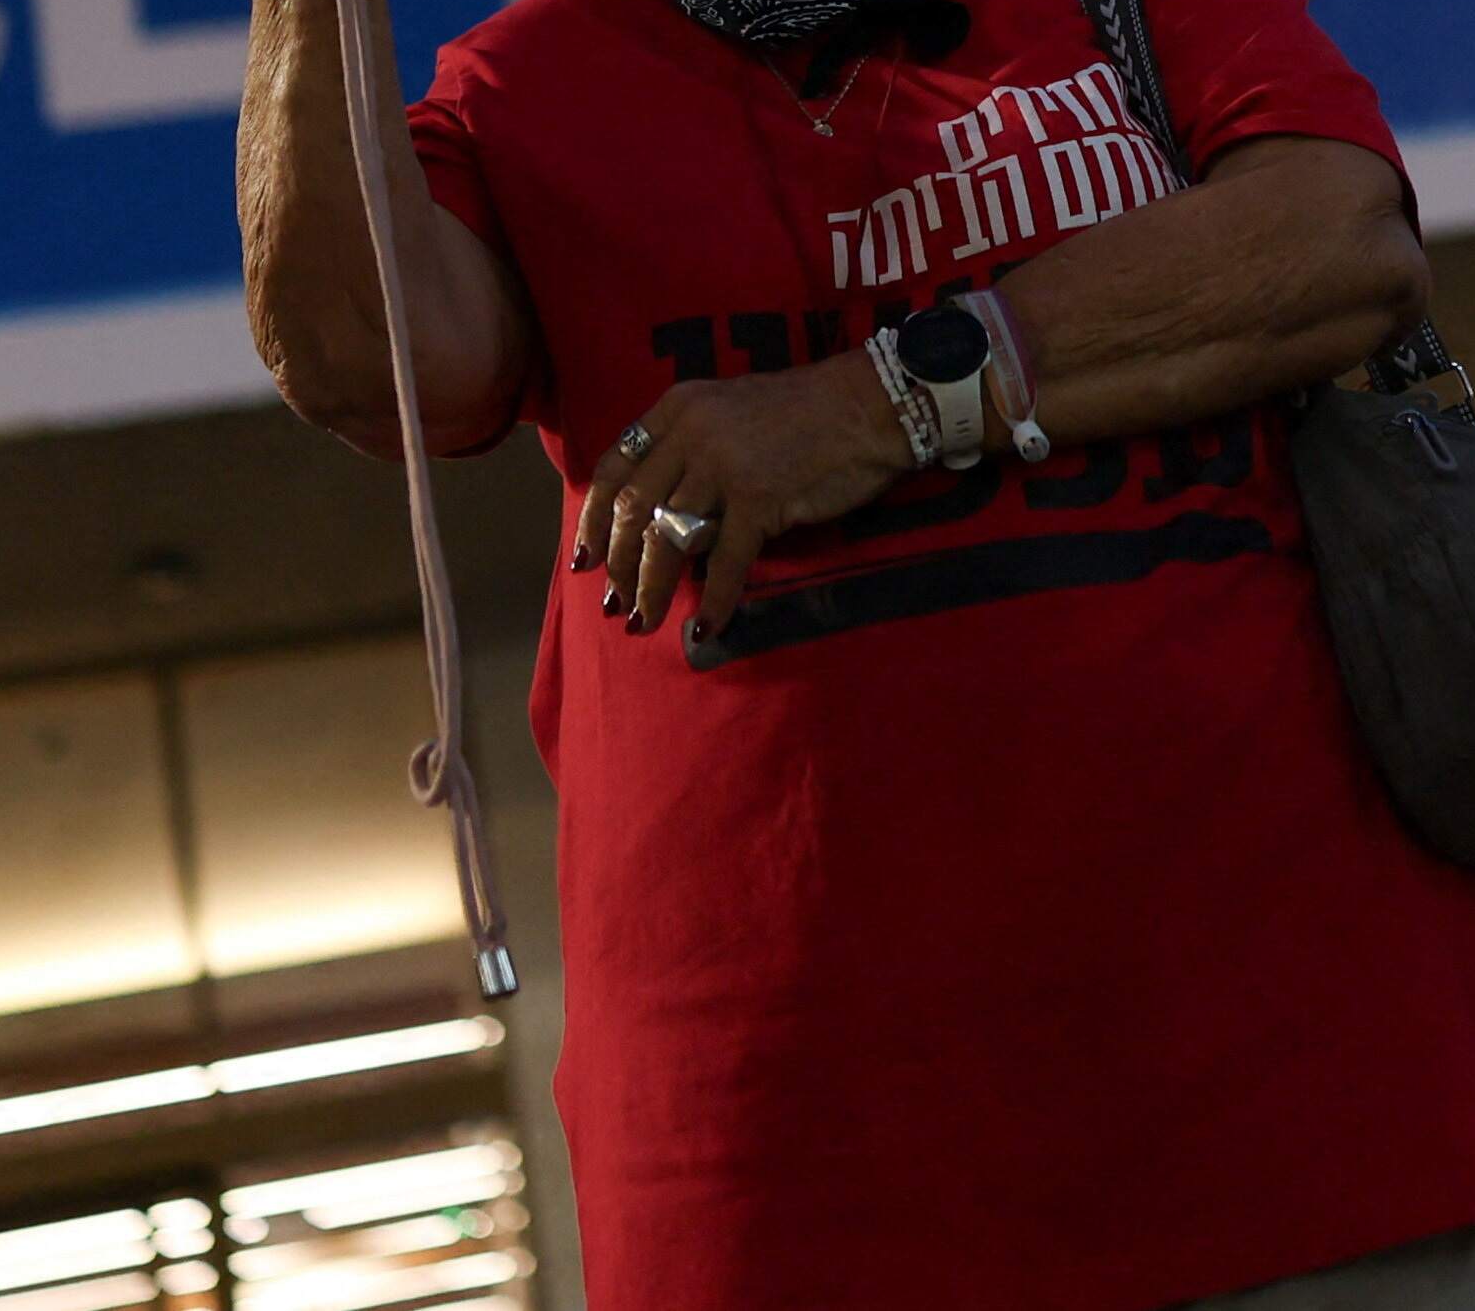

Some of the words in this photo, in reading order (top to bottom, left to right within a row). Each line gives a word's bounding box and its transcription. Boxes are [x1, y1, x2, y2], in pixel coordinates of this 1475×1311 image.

[937, 62, 1161, 174] חזירים
[827, 153, 1036, 290] הביתה
[1038, 131, 1191, 231] ותם
